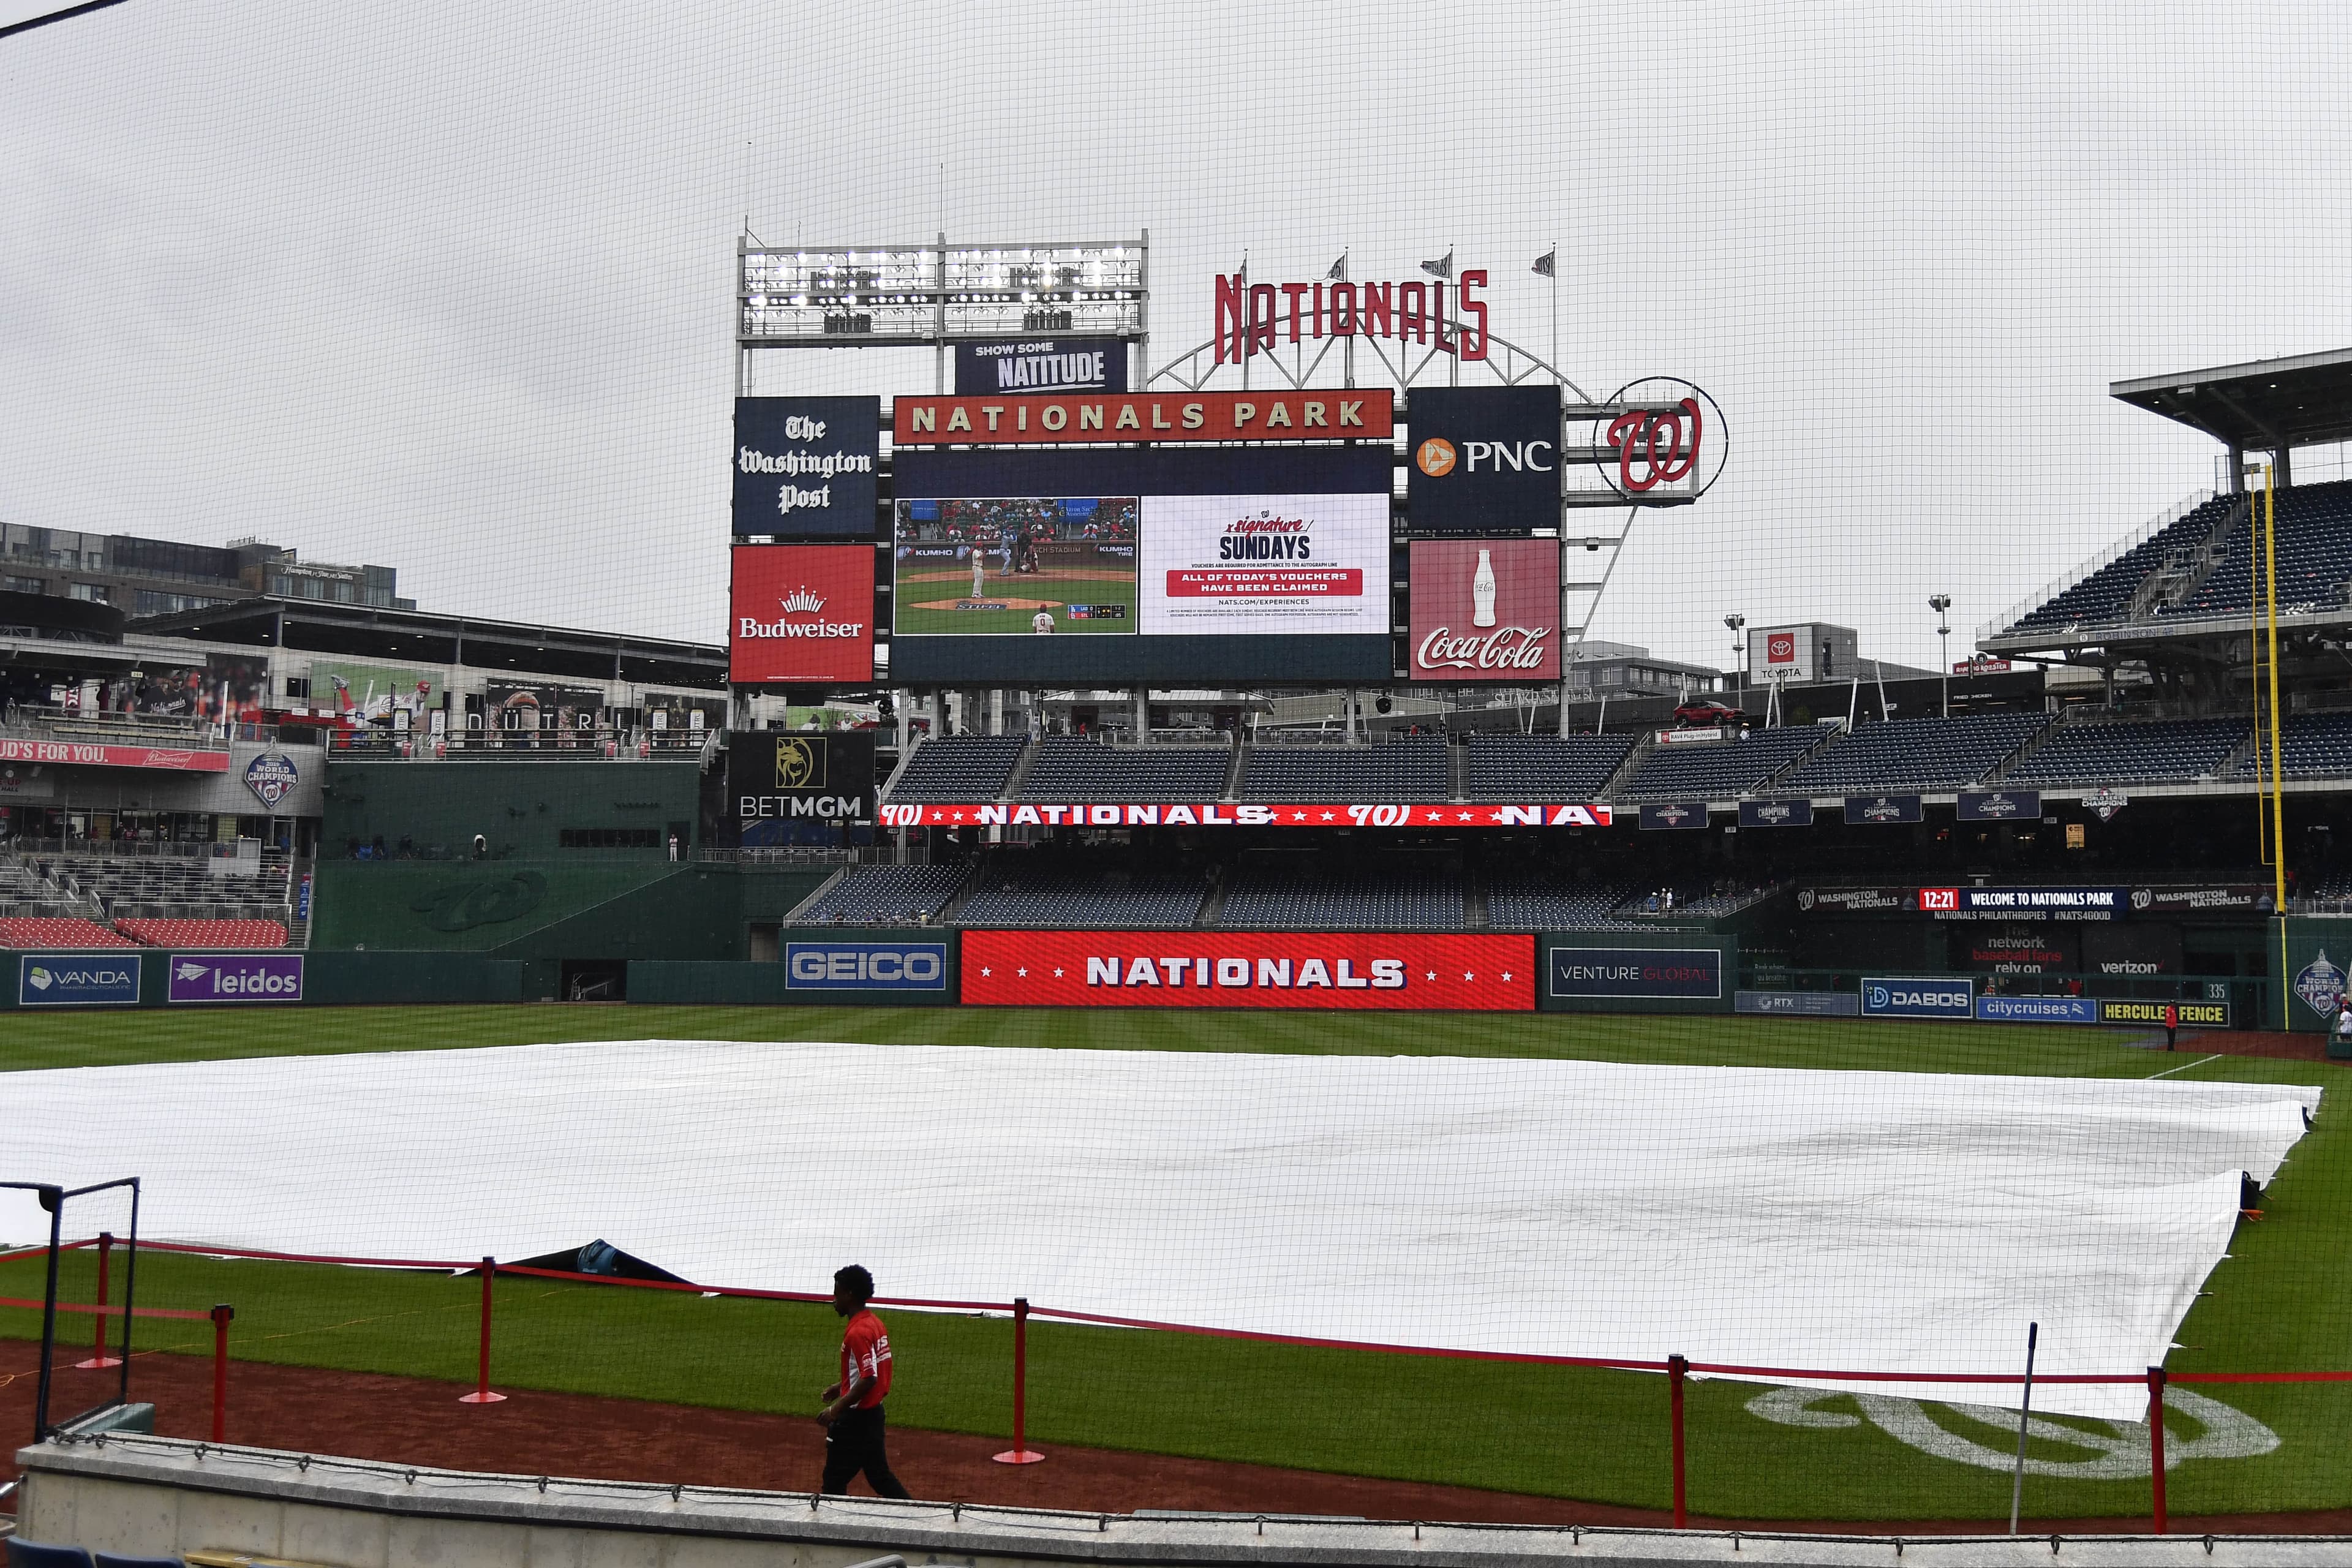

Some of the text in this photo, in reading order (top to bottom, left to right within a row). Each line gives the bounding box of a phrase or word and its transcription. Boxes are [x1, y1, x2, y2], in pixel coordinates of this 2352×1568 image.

[1215, 270, 1487, 364] NATIONALS
[976, 342, 1054, 356] SHOW SOME
[998, 352, 1105, 388] NATITUDE
[913, 400, 1365, 432] NATIONALS PARK
[785, 415, 827, 442] The
[739, 445, 872, 479] Washington
[1463, 440, 1553, 473] PNC
[778, 484, 831, 514] Post
[1234, 516, 1303, 540] signature
[1219, 535, 1310, 560] SUNDAYS
[739, 617, 863, 638] Budweiser
[2095, 630, 2156, 641] ROBINSON
[1417, 626, 1552, 669] Coca-Cola
[1762, 668, 1801, 678] TOYOTA
[37, 744, 69, 760] FOR
[73, 745, 108, 763] YOU.
[149, 753, 189, 764] Budweiser
[256, 764, 290, 774] WORLD
[247, 772, 296, 784] CHAMPIONS
[740, 796, 861, 818] BETMGM
[1757, 807, 1790, 818] CHAMPIONS
[1864, 807, 1900, 819] CHAMPIONS
[1978, 804, 2017, 812] CHAMPIONS
[980, 805, 1269, 825] NATIONALS
[1817, 890, 1879, 903] WASHINGTON
[1924, 891, 1954, 908] 12:21
[1971, 892, 2114, 906] WELCOME TO NATIONALS PARK
[2155, 889, 2228, 902] WASHINGTON
[2189, 895, 2252, 908] NATIONALS
[1847, 897, 1898, 910] NATIONALS
[1934, 911, 2111, 921] NATIONALS PHILANTHROPIES #NATS4GOOD
[1988, 937, 2045, 948] network
[1972, 949, 2063, 962] baseball fans
[791, 951, 941, 981] GEICO
[1087, 956, 1405, 989] NATIONALS
[2023, 963, 2041, 974] on
[2100, 960, 2158, 974] verizon
[55, 971, 130, 984] VANDA
[214, 968, 297, 993] leidos
[1559, 965, 1711, 982] VENTURE GLOBAL
[2305, 976, 2340, 985] WORLD
[2208, 984, 2225, 998] 335
[1774, 998, 1794, 1008] RTX
[1891, 992, 1968, 1006] DABOS
[1987, 1000, 2068, 1017] citycruises
[2105, 1003, 2223, 1022] HERCULE FENCE
